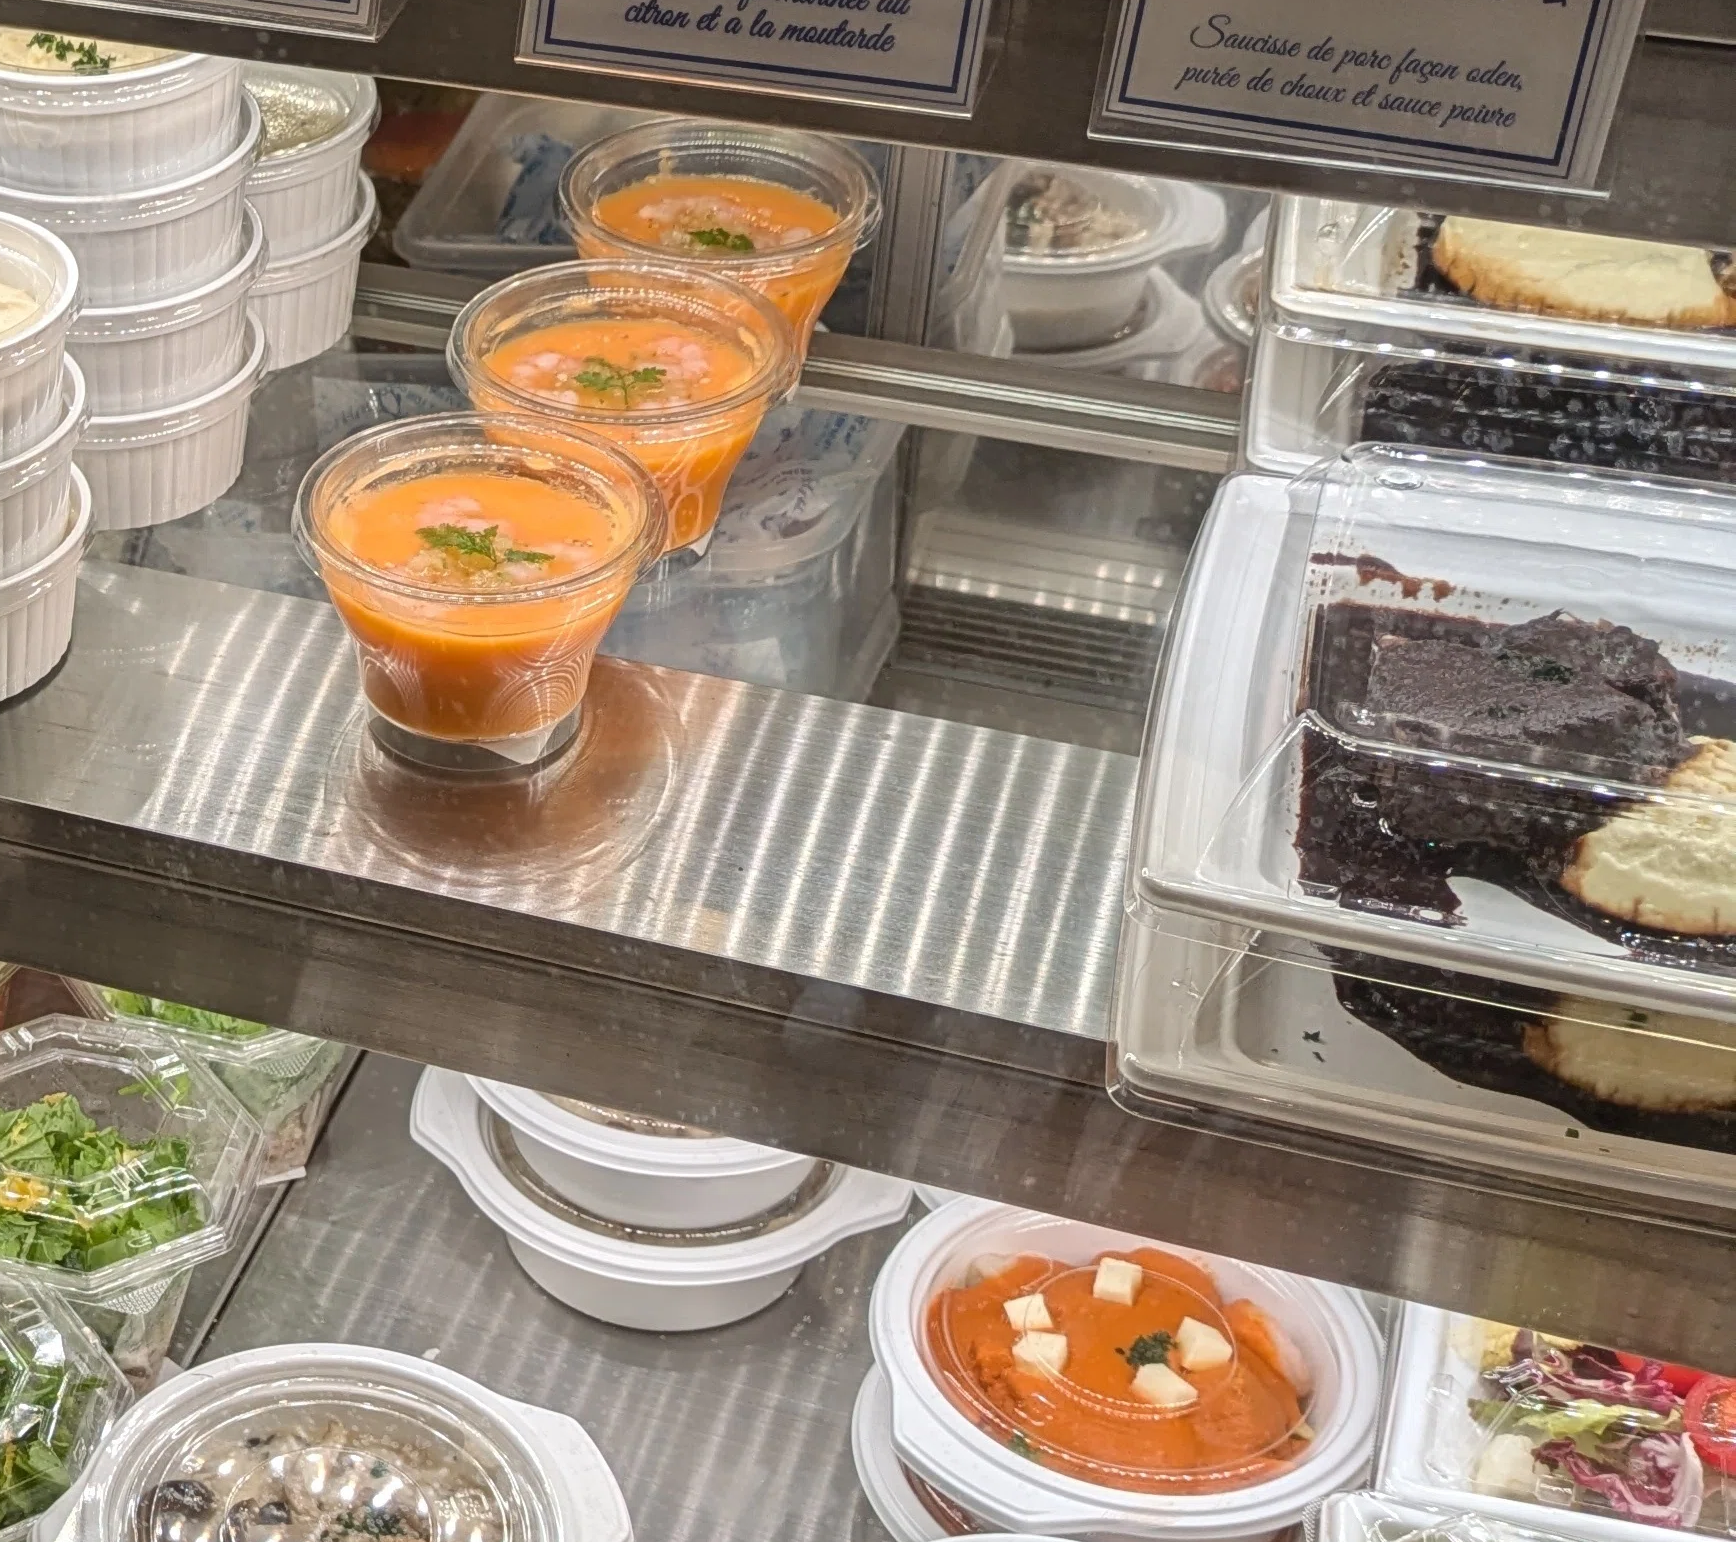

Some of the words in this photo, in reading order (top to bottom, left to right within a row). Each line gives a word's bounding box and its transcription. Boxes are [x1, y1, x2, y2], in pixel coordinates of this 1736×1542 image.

[625, 2, 690, 31] citron
[697, 7, 719, 33] et
[725, 17, 742, 34] a
[750, 10, 775, 38] la
[779, 19, 896, 53] moutarde
[1190, 14, 1301, 58] Saucisse
[1308, 36, 1335, 63] de
[1340, 46, 1392, 74] porc
[1389, 49, 1459, 84] façon
[1175, 63, 1240, 90] purée
[1246, 67, 1273, 93] de
[1280, 75, 1346, 103] choux
[1351, 83, 1374, 107] et
[1379, 91, 1441, 117] sauce
[1439, 105, 1517, 128] poivre
